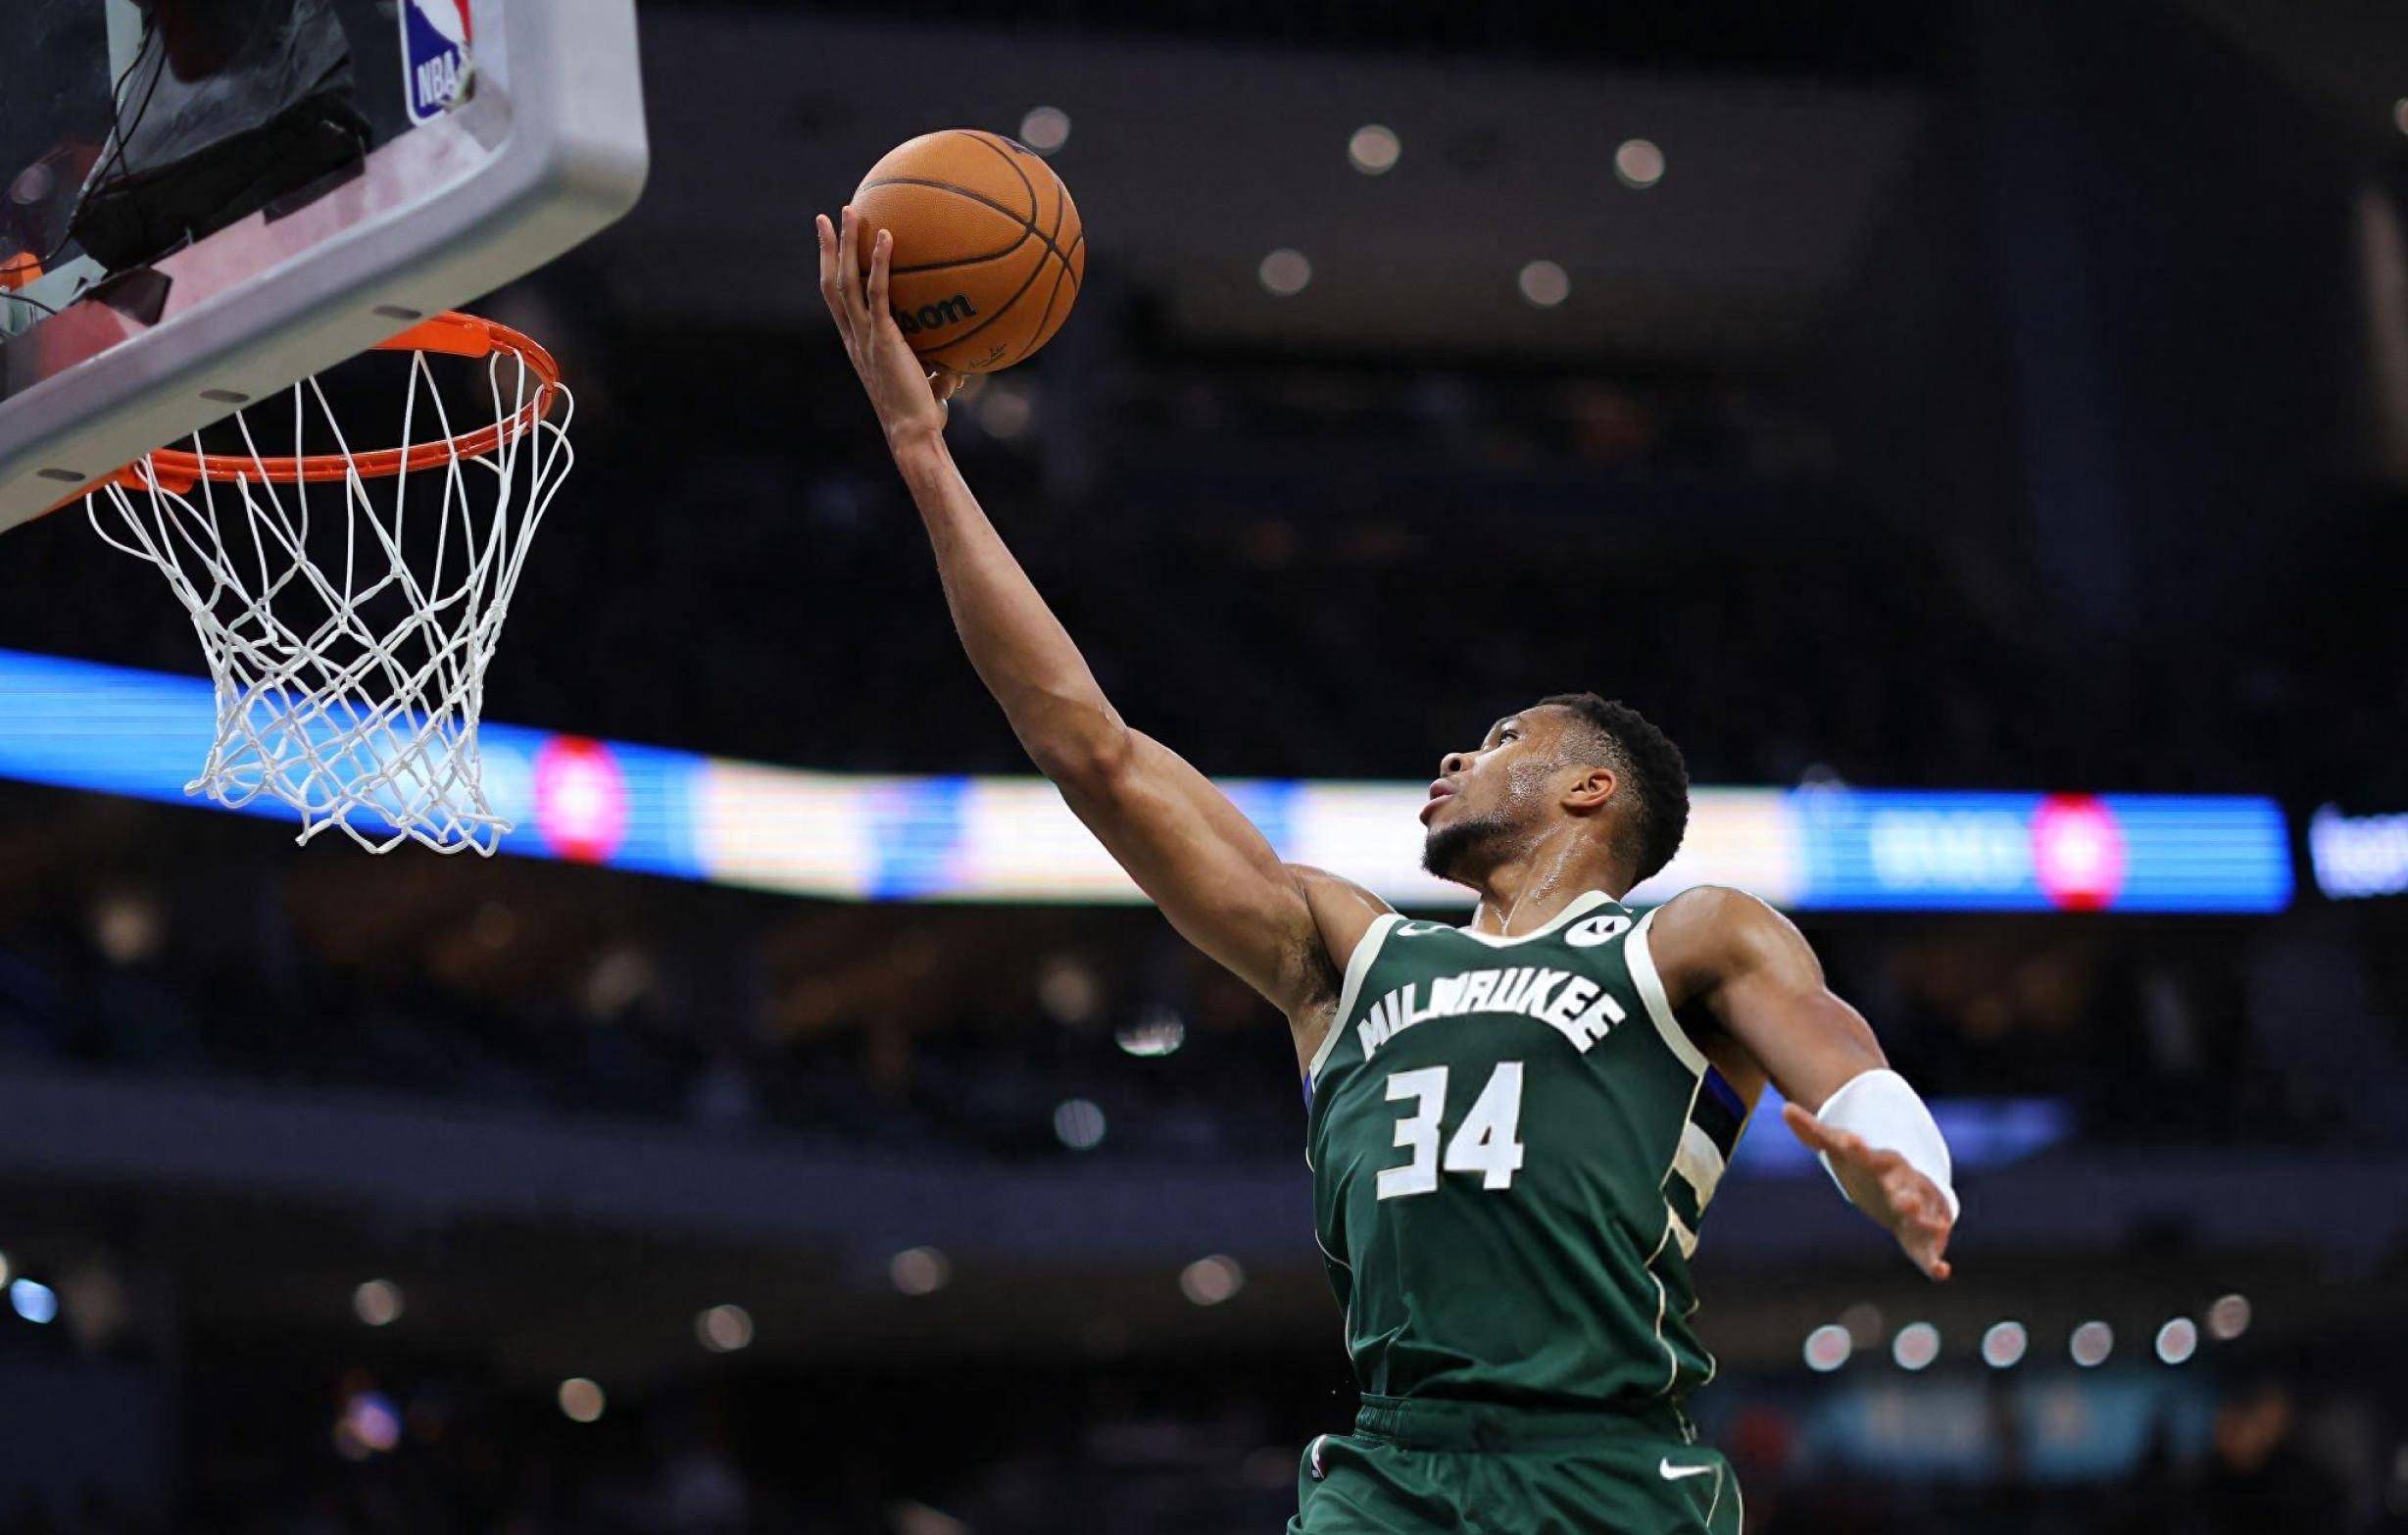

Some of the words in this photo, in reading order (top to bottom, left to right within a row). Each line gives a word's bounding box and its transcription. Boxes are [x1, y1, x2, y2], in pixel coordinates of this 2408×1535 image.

[417, 49, 458, 108] NBA
[897, 293, 977, 333] son
[1356, 966, 1626, 1063] MILWAUKEE
[1376, 1062, 1524, 1201] 34
